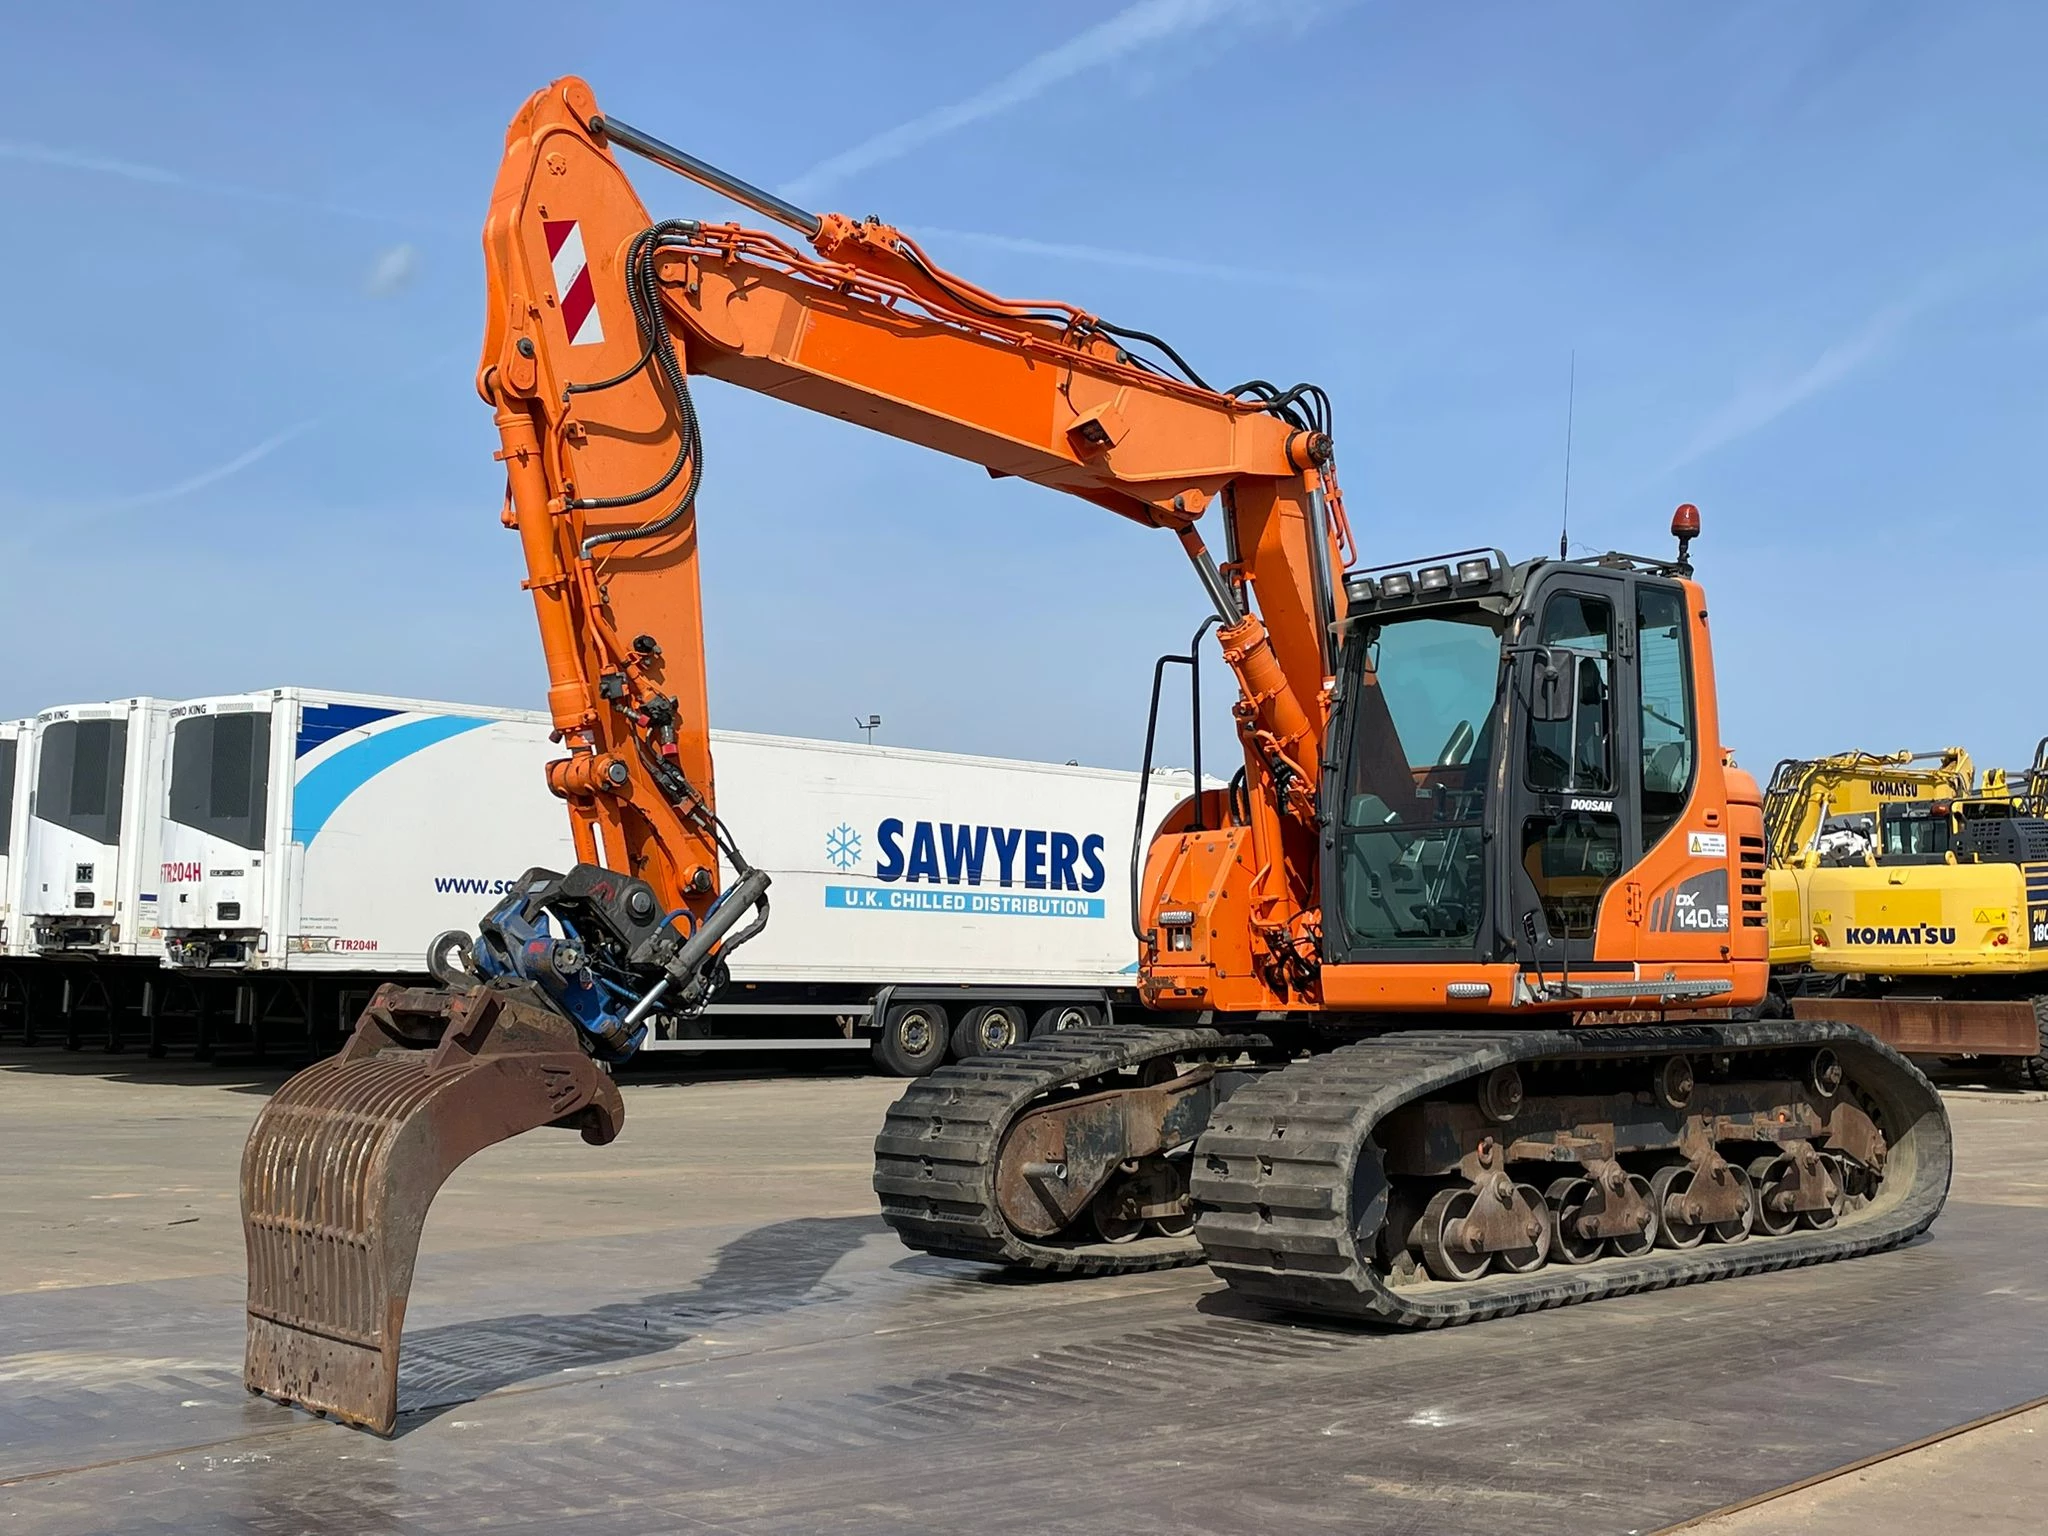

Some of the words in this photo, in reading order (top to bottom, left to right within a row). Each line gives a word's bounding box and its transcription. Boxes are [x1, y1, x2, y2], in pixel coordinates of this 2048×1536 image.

[188, 704, 206, 715] KING
[1871, 780, 1918, 797] KOMATSU
[1571, 799, 1613, 812] DOOSAN
[876, 817, 1105, 893] SAWYERS
[160, 862, 202, 883] FTR204H
[845, 890, 883, 907] U.K.
[890, 892, 965, 911] CHILLED
[972, 897, 1089, 916] DISTRIBUTION
[1676, 892, 1700, 906] DX
[2033, 909, 2047, 923] PW
[1846, 923, 1956, 945] KOMATSU
[334, 940, 378, 951] FTR204H
